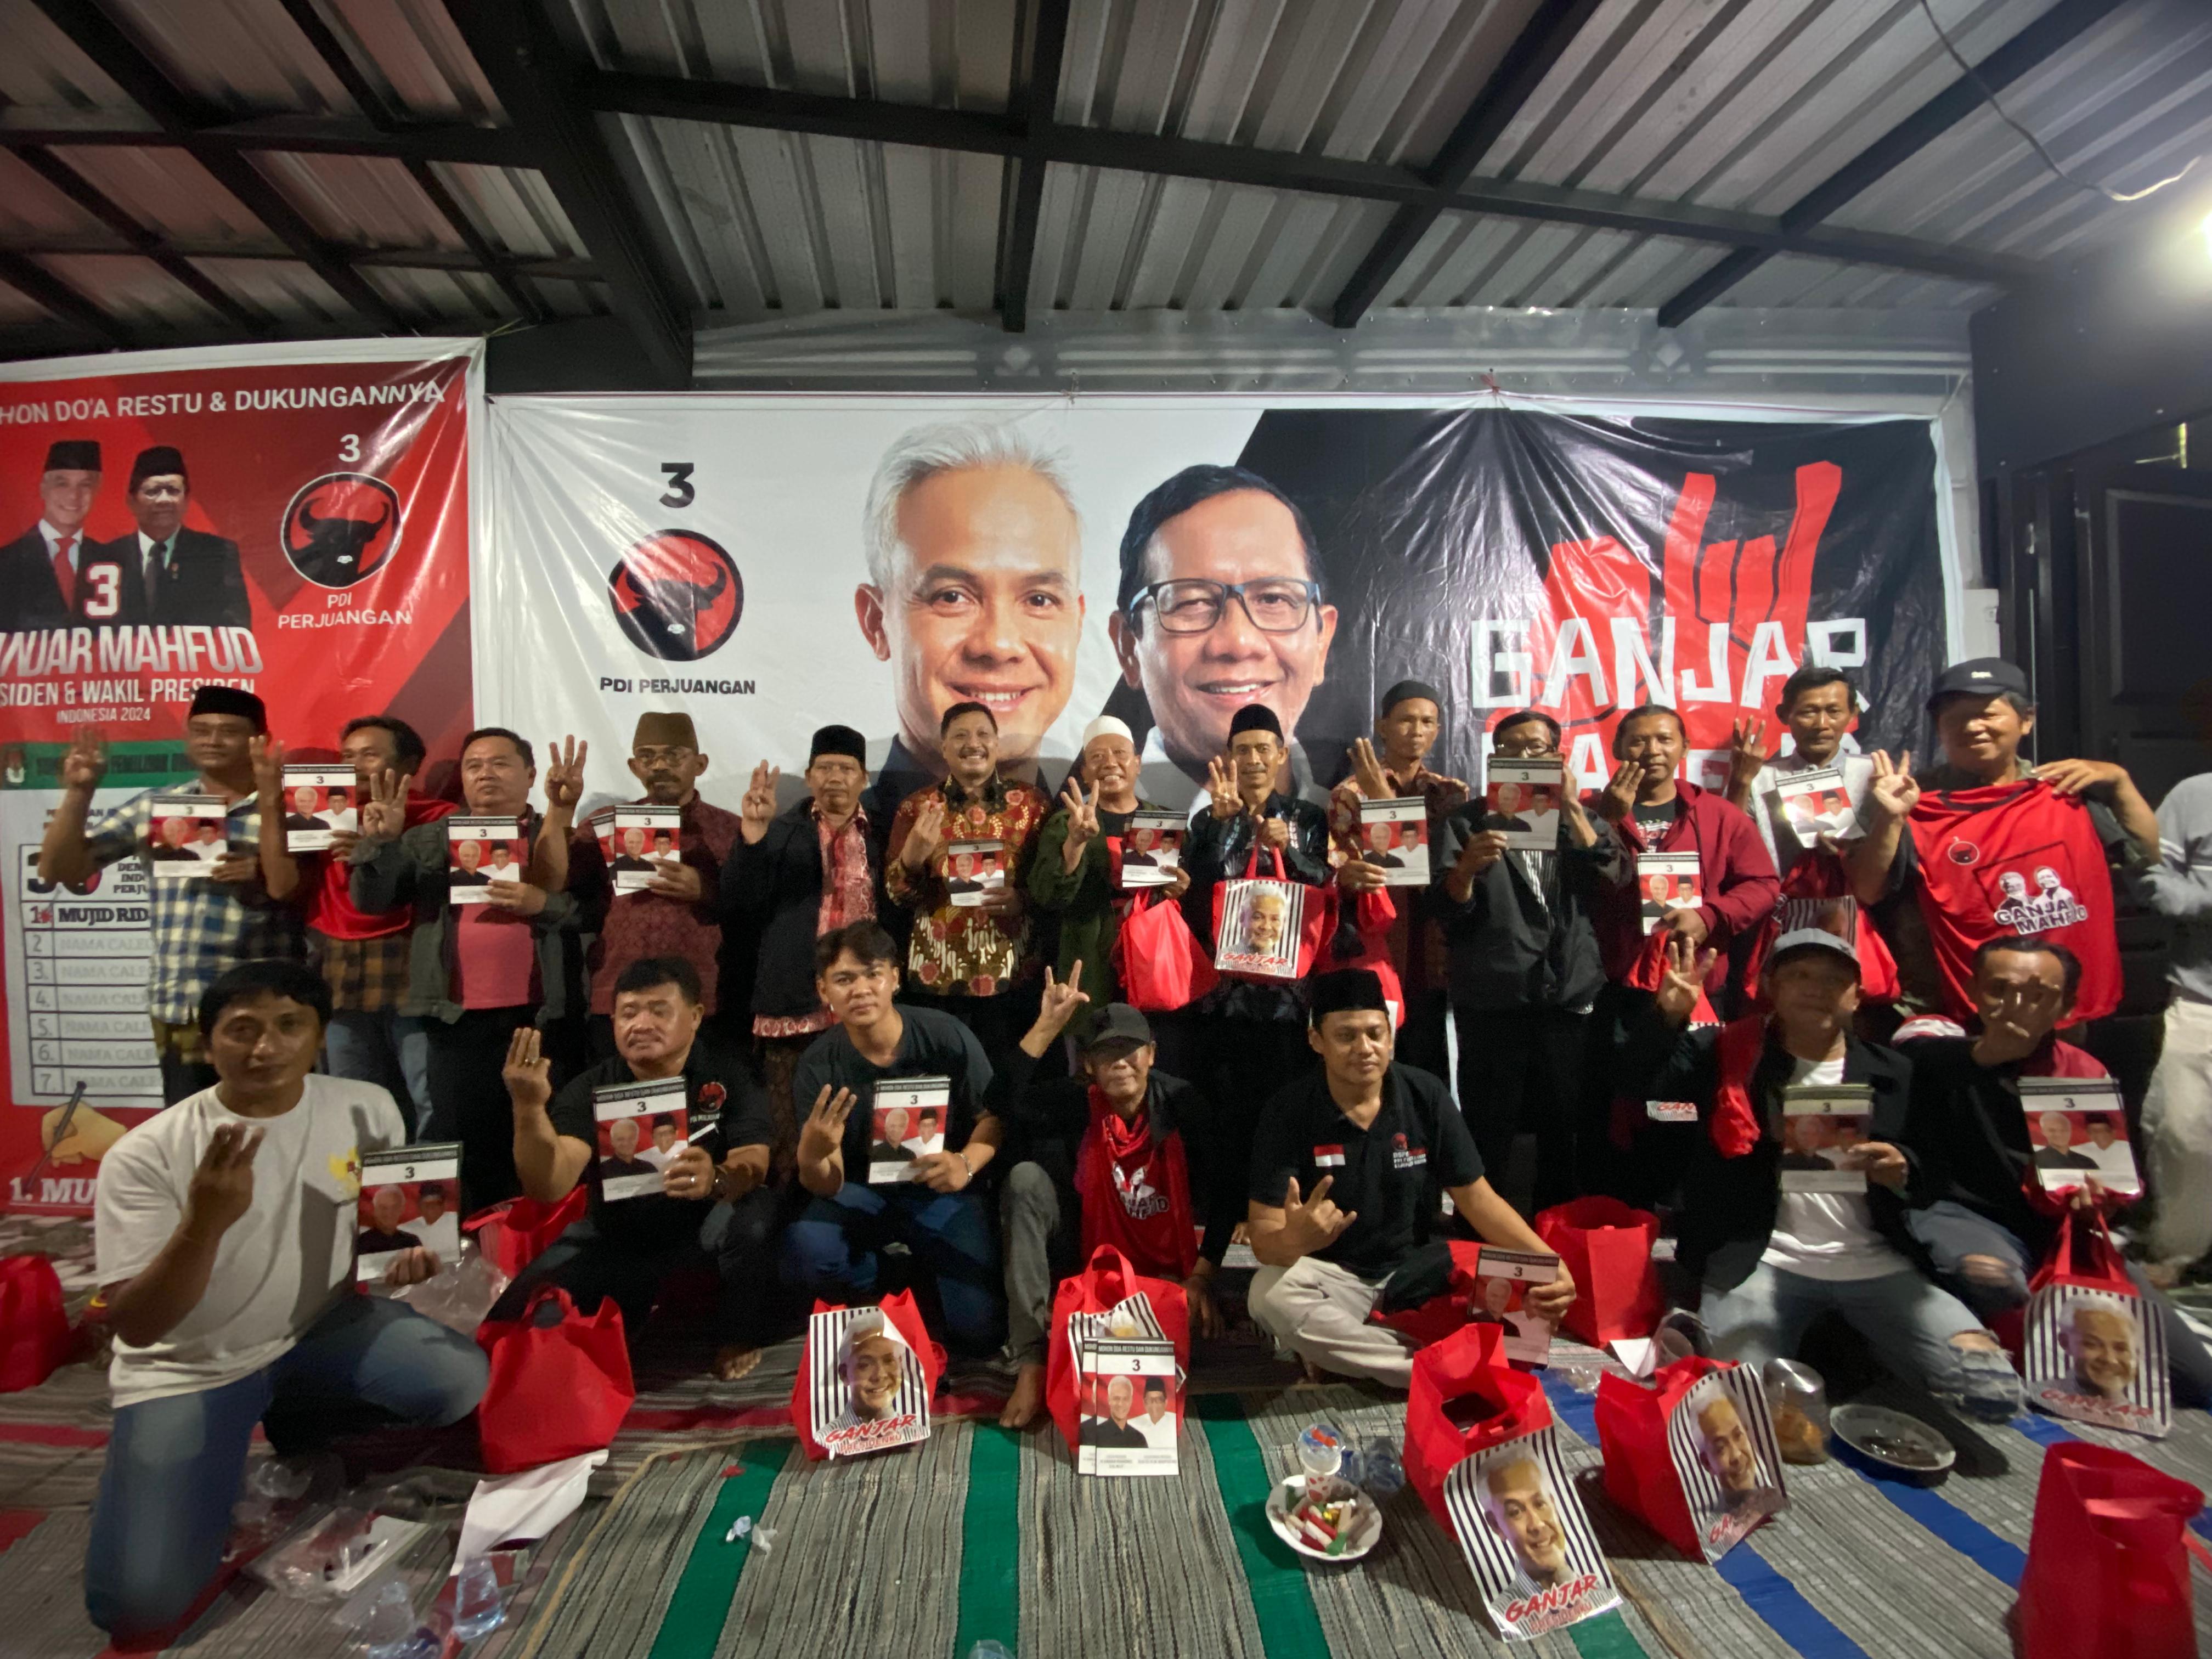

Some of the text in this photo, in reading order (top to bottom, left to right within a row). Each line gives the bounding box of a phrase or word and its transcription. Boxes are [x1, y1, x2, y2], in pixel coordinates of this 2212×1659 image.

[55, 399, 110, 421] DO'A
[117, 393, 202, 416] RESTU
[210, 392, 227, 412] &
[235, 380, 445, 411] DUKUNGANNYA
[338, 434, 361, 462] 3
[658, 462, 696, 509] 3
[87, 564, 120, 618] 3
[328, 592, 352, 609] PDI
[278, 610, 413, 629] PERJUANGAN
[99, 625, 264, 674] MAHFUD
[1471, 616, 1870, 713] GANJAR
[0, 678, 256, 707] SIDEN & WAKIL PRESN
[600, 676, 755, 695] PDI PERJUANGAN
[57, 707, 151, 724] INDONESIA 2024
[316, 776, 324, 784] 3
[1521, 771, 1530, 781] 3
[644, 817, 652, 826] 3
[1390, 811, 1397, 820] 3
[480, 829, 487, 837] 3
[1666, 864, 1673, 872] 3
[58, 907, 114, 926] MUJID
[1223, 952, 1288, 966] GANJAR
[38, 1044, 54, 1062] 6.
[637, 1101, 646, 1113] 3
[910, 1094, 918, 1105] 3
[1822, 1102, 1831, 1113] 3
[2063, 1098, 2075, 1108] 3
[405, 1166, 415, 1178] 3
[10, 1177, 33, 1201] 1.
[1513, 1266, 1523, 1277] 3
[1132, 1359, 1141, 1372] 3
[825, 1414, 917, 1443] GANJAR
[1505, 1575, 1598, 1623] GANJAR
